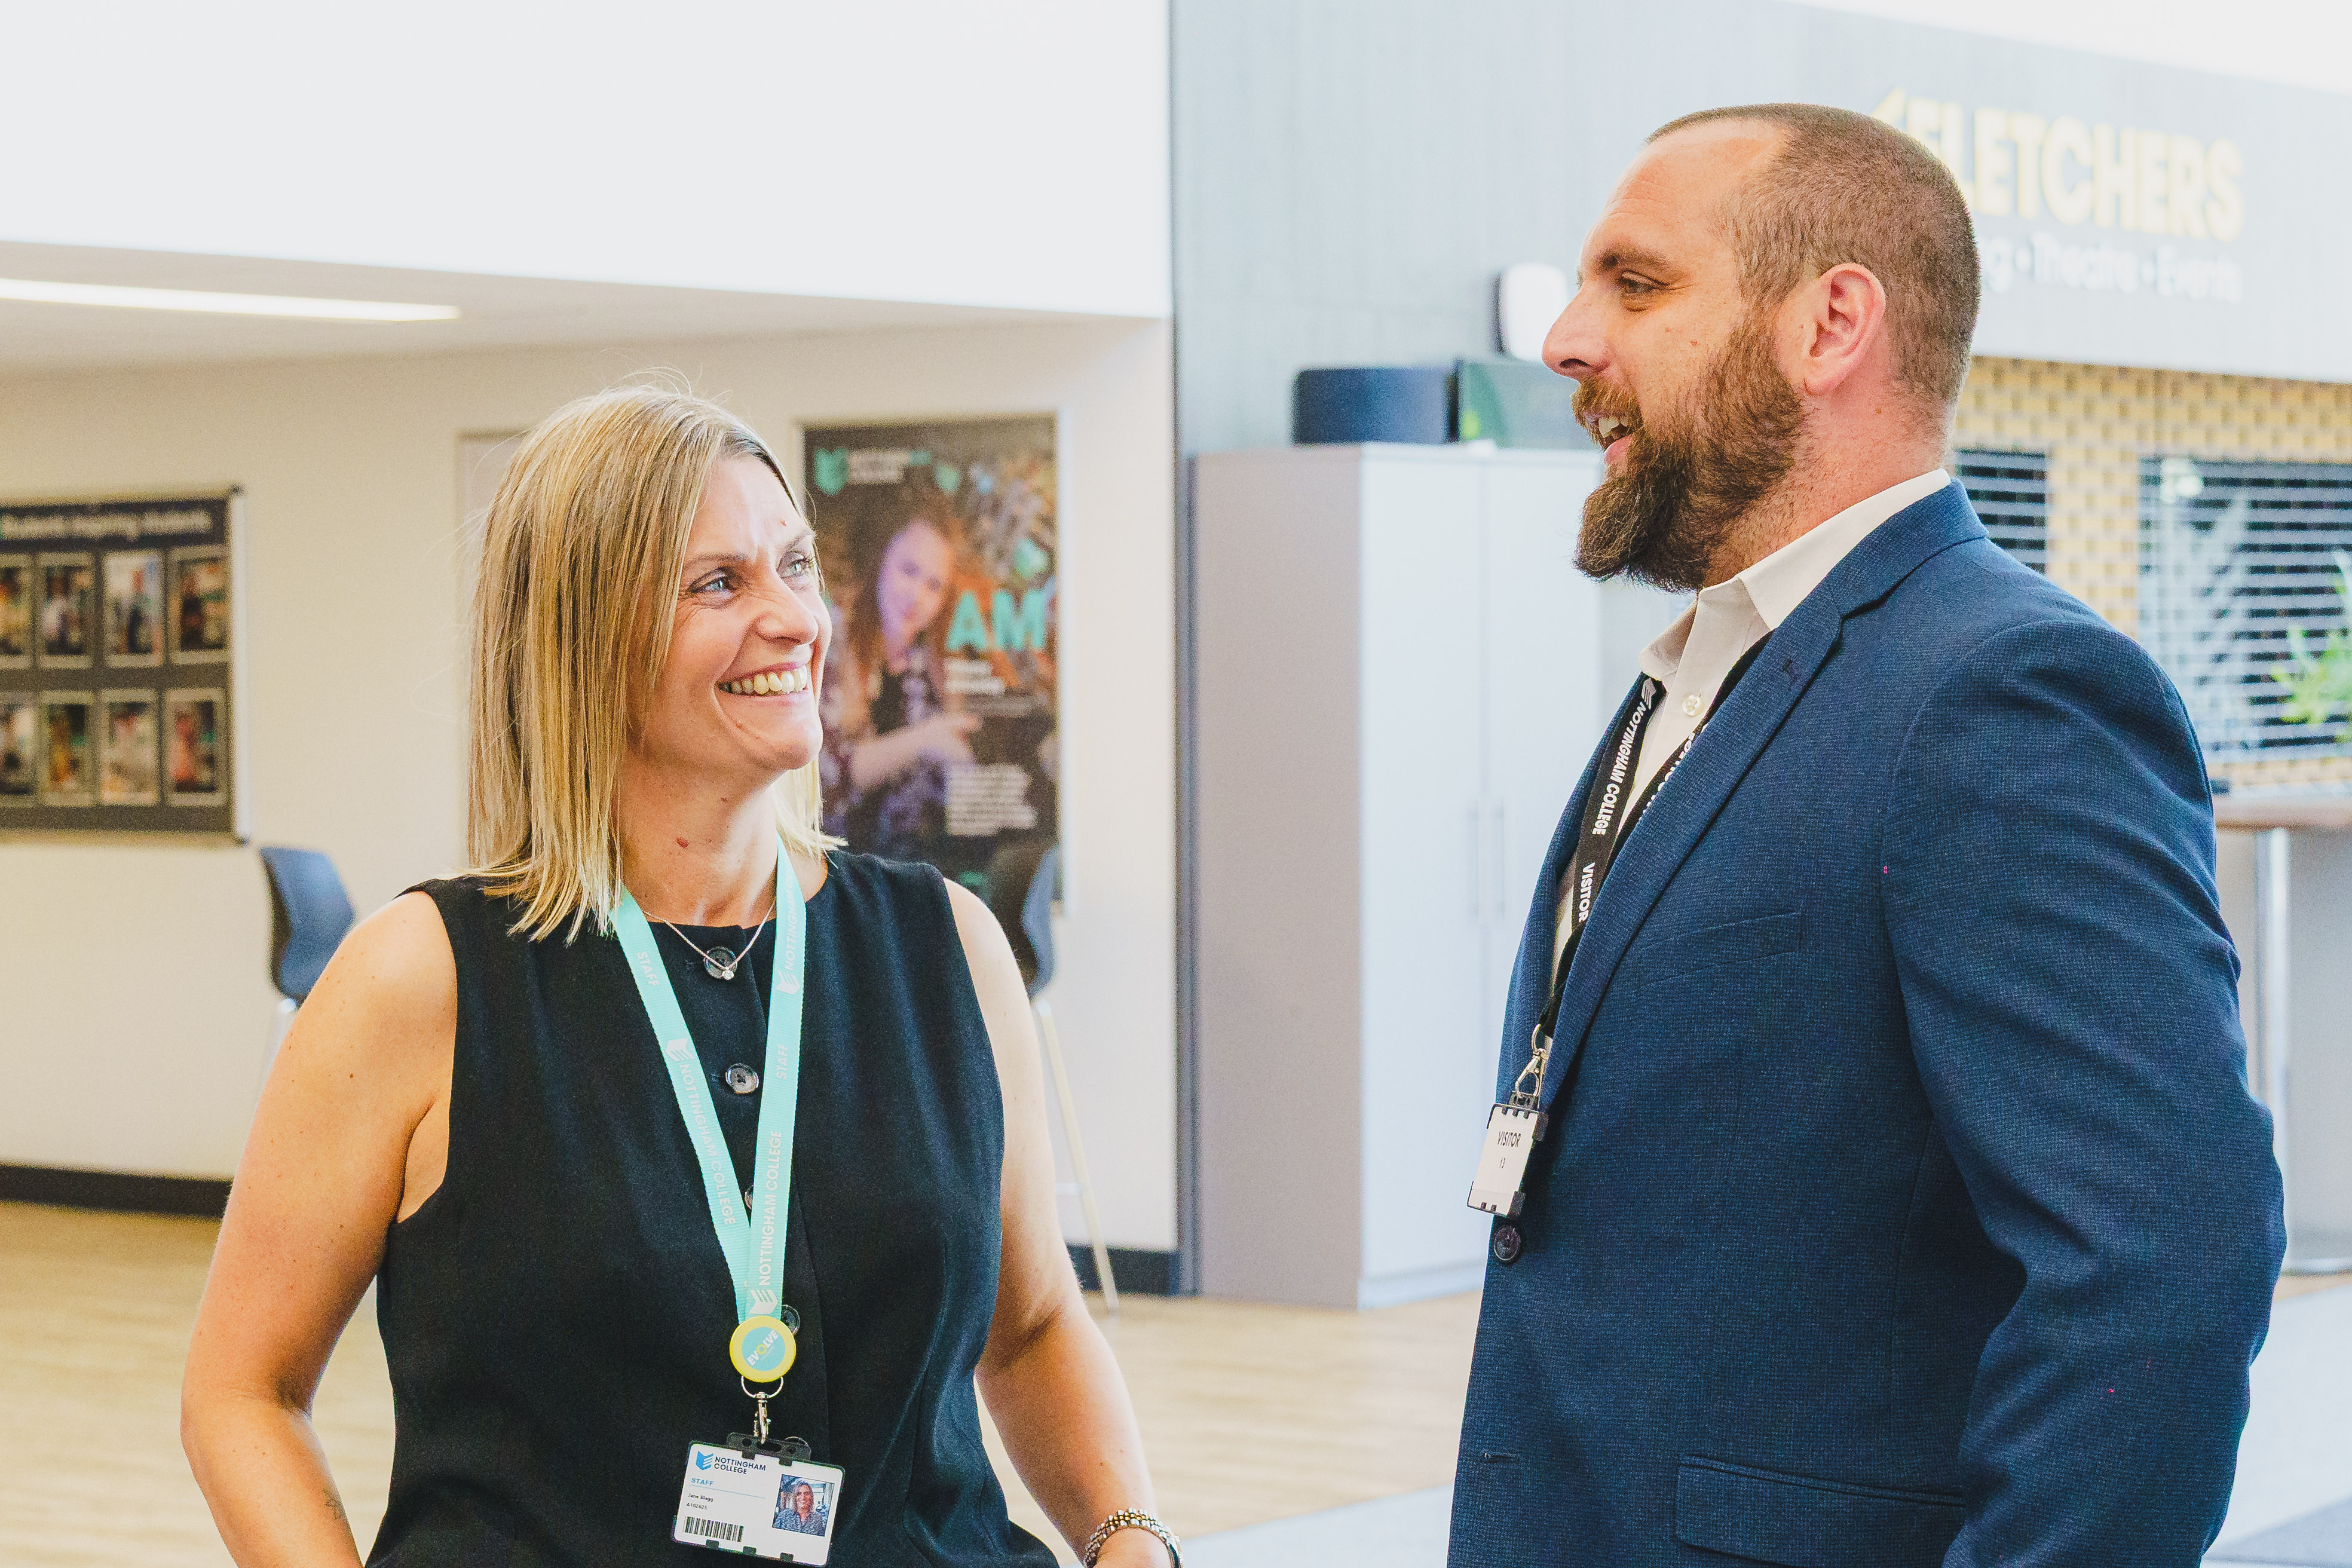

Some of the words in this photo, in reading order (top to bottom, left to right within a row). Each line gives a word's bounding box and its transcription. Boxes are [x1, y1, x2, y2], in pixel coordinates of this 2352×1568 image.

[945, 589, 1046, 651] AM
[1610, 702, 1646, 784] NOTTINGHAM
[1592, 783, 1620, 835] COLLEGE
[1578, 862, 1595, 923] VISITOR
[785, 891, 797, 971] NOTTINGHAM
[637, 951, 658, 987] STAFF
[777, 1043, 789, 1080] STAFF
[679, 1064, 717, 1157] NOTTINGHAM
[711, 1160, 736, 1225] COLLEGE
[766, 1131, 782, 1193] COLLEGE
[1497, 1131, 1521, 1147] VISITOR
[758, 1195, 776, 1286] NOTTINGHAM
[747, 1330, 779, 1366] EVOLVE
[691, 1477, 714, 1486] STAFF
[714, 1463, 748, 1474] COLLEGE
[715, 1456, 766, 1471] NOTTINGHAM
